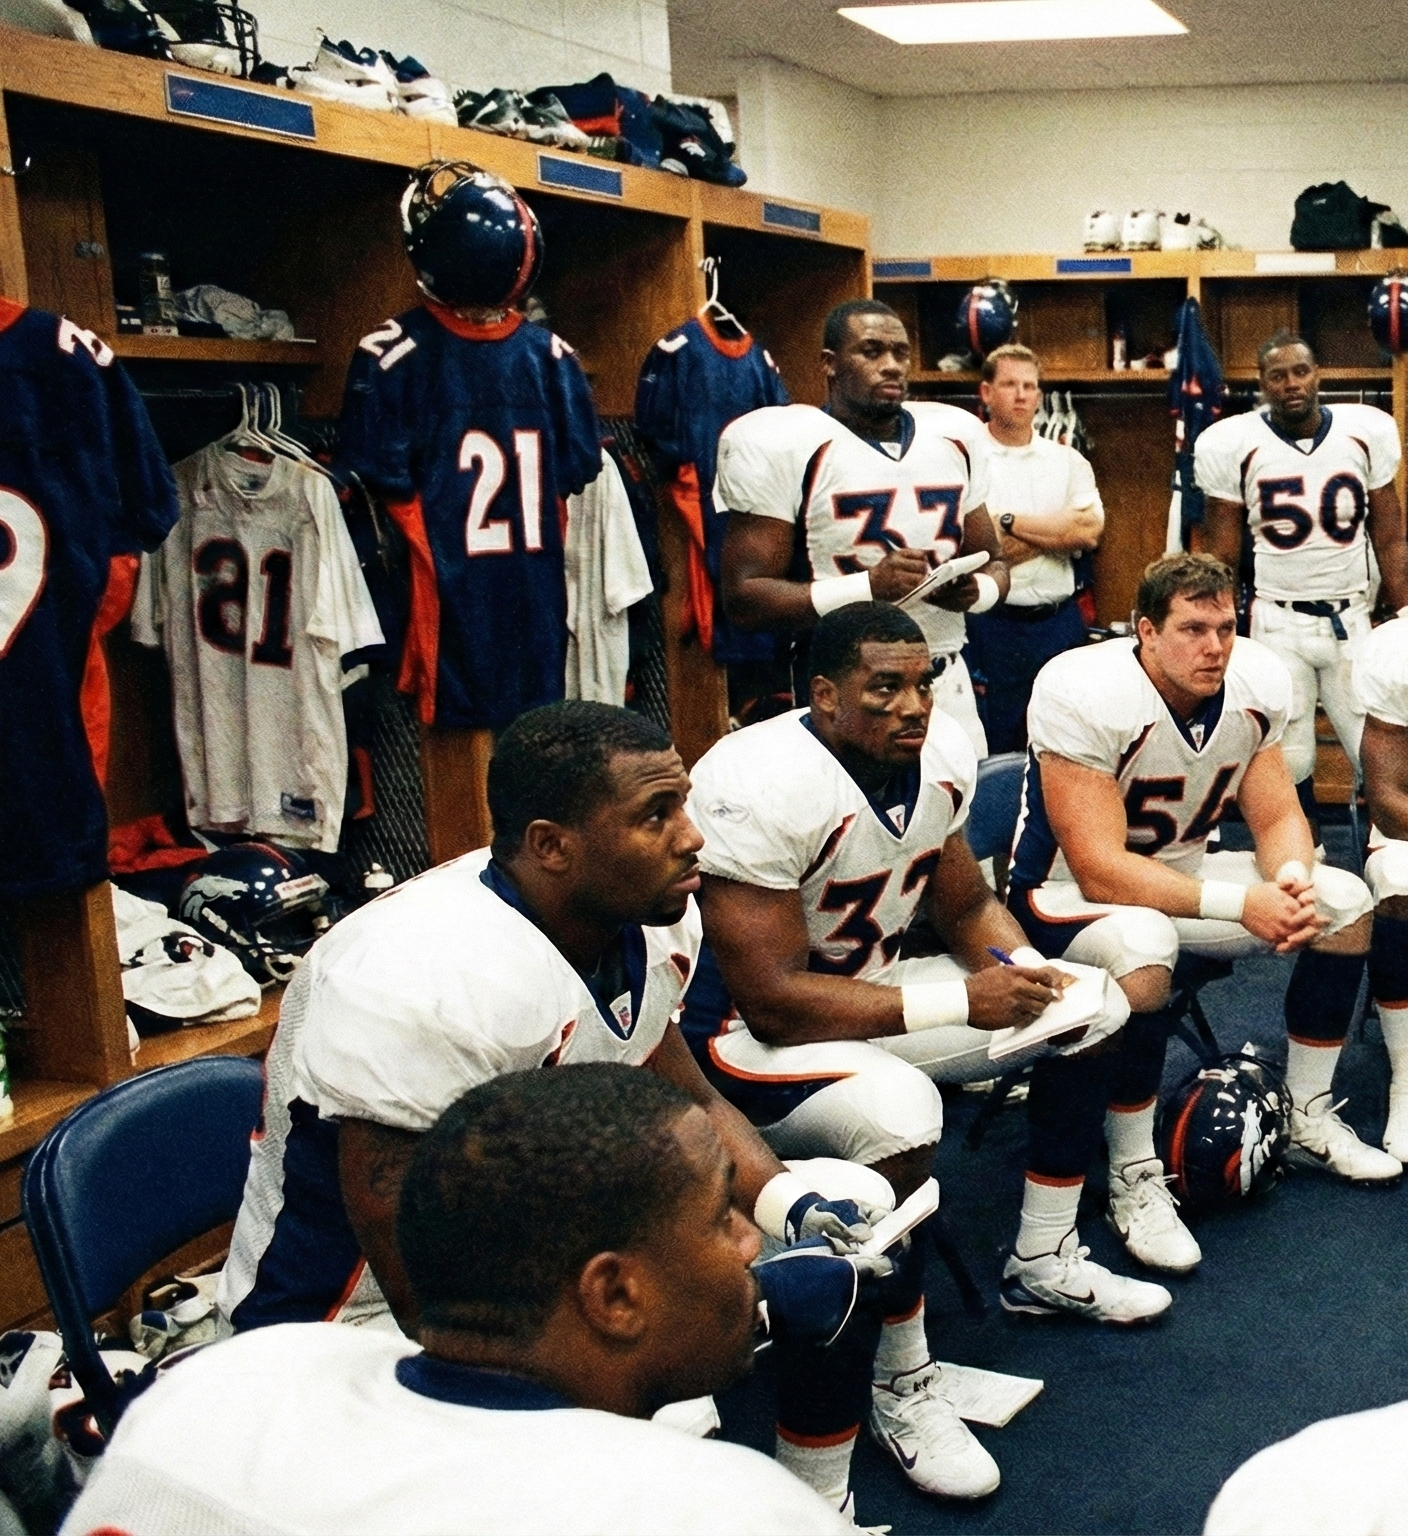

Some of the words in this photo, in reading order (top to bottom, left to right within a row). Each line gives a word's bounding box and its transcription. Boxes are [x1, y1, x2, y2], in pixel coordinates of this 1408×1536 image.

[457, 426, 543, 557] 21
[831, 484, 964, 577] 33
[1257, 472, 1366, 550] 50
